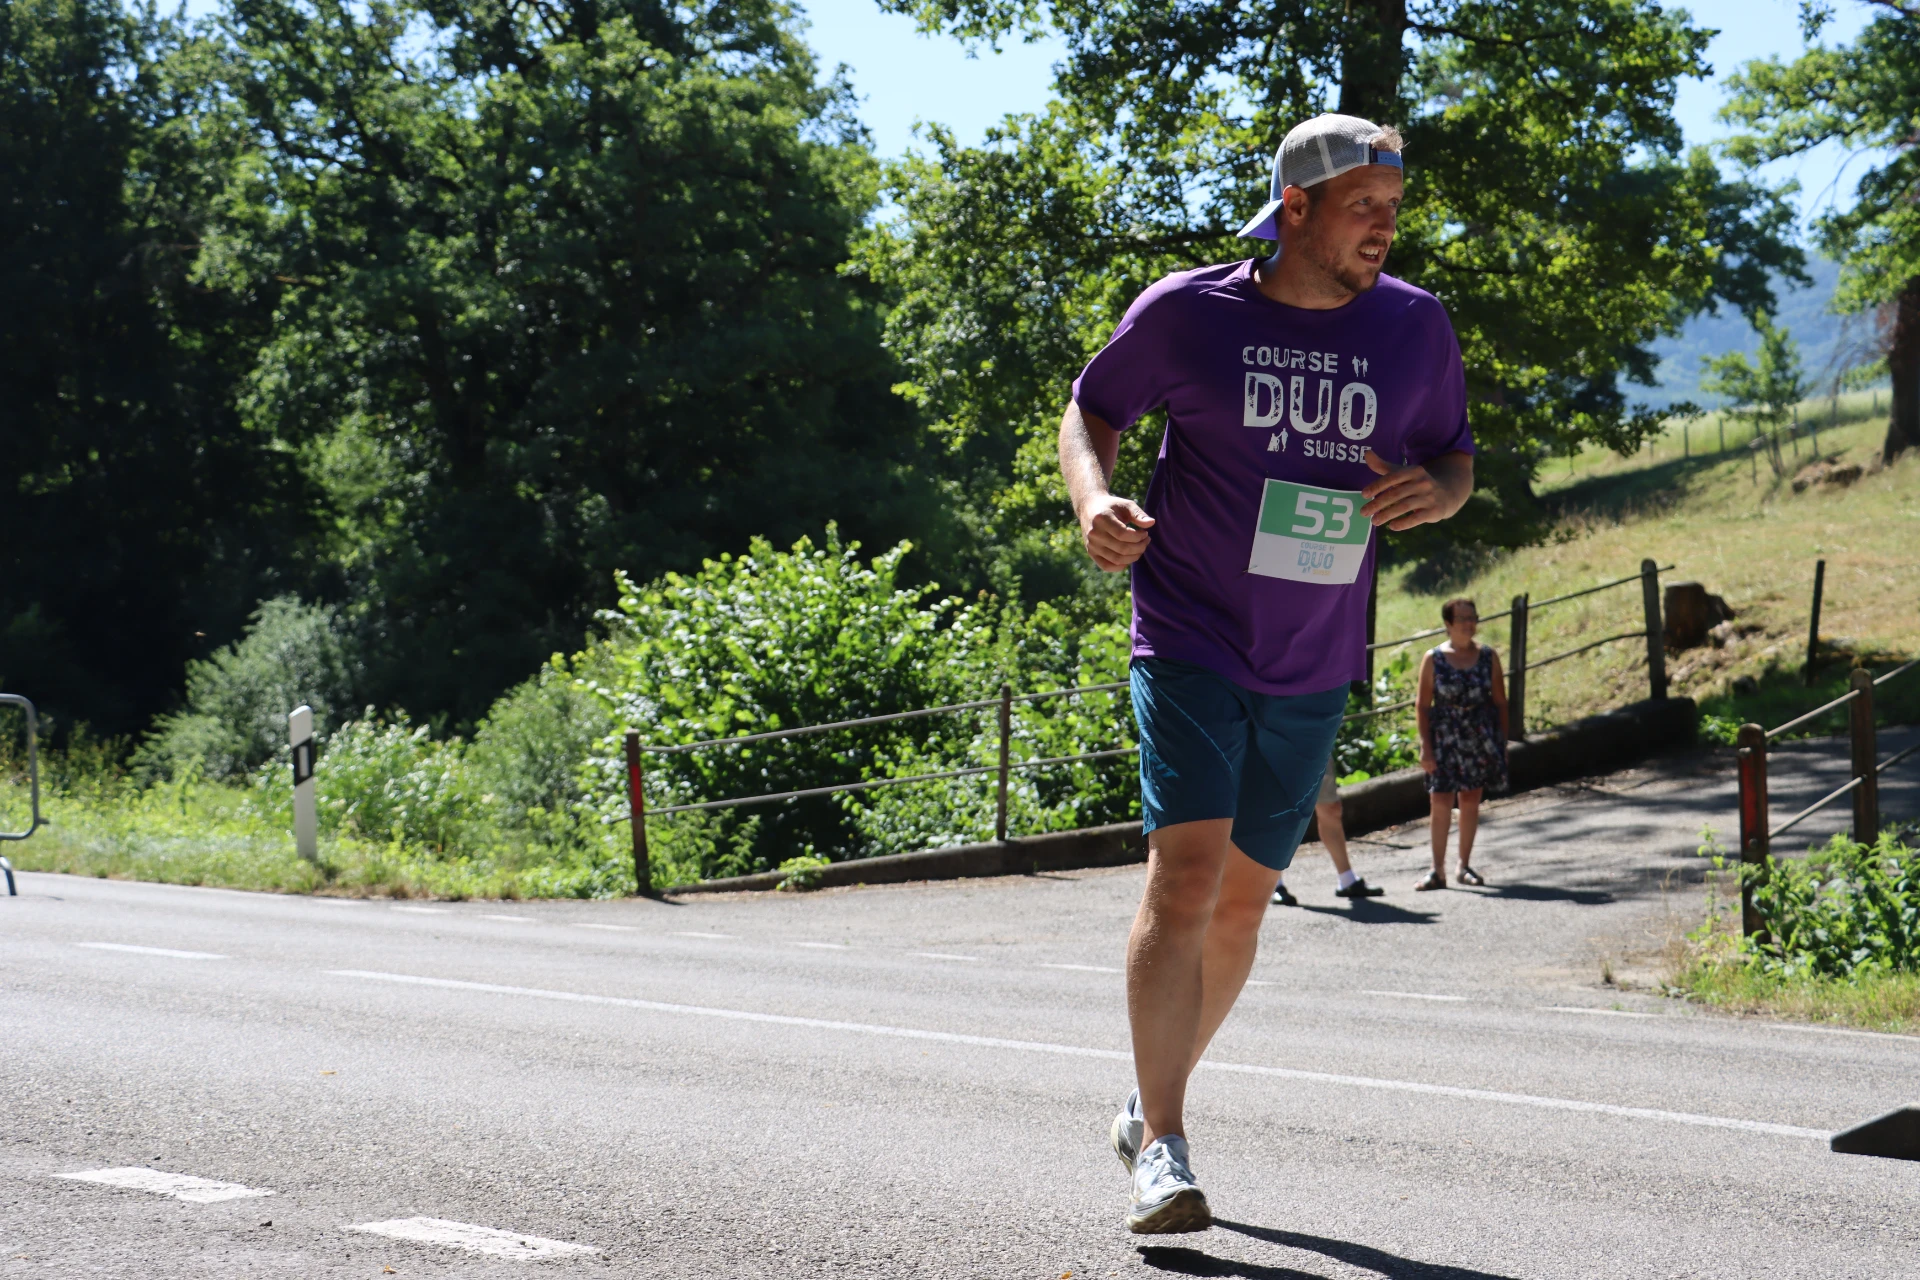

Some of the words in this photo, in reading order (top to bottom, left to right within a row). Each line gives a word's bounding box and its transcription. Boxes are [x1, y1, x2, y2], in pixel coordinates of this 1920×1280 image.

[1242, 346, 1338, 373] COURSE
[1243, 371, 1377, 441] DUO
[1303, 438, 1372, 463] SUISSE
[1291, 491, 1354, 539] 53
[1300, 541, 1328, 551] COURSE
[1297, 549, 1335, 570] DUO
